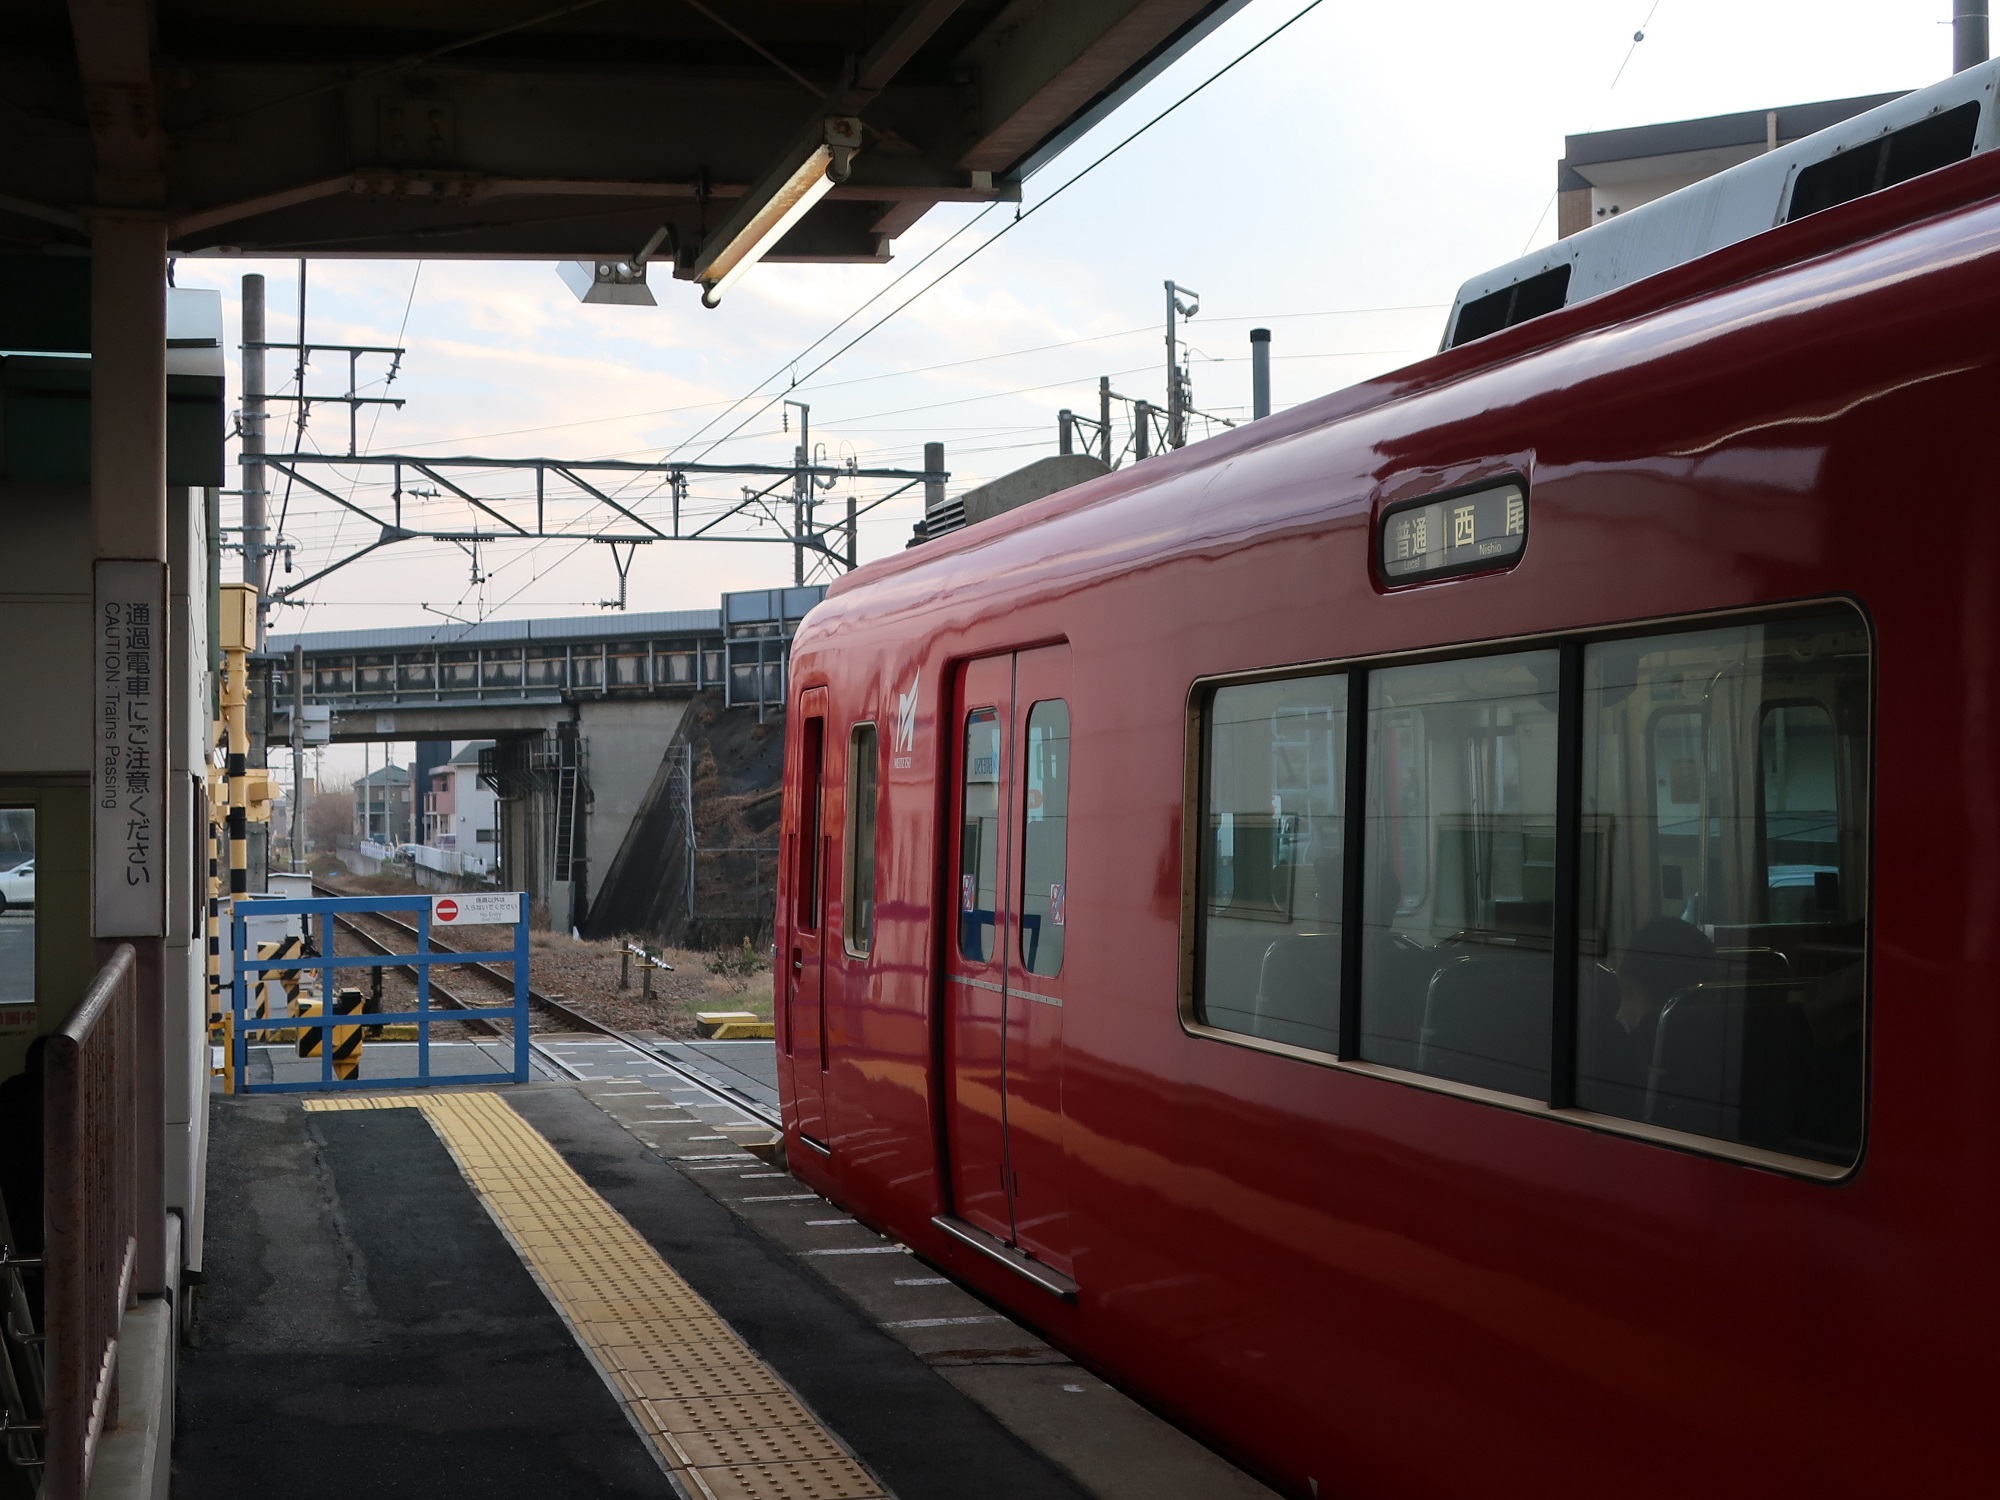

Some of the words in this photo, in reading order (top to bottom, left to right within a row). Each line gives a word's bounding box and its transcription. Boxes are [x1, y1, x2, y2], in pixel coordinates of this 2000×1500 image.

[1396, 516, 1427, 560] 普通
[1479, 542, 1502, 556] Nishio
[1404, 558, 1420, 571] Local
[105, 602, 120, 689] CAUTION:
[105, 691, 121, 740] Trains
[126, 602, 150, 886] 通過電車にご注意ください
[101, 745, 120, 809] Passing
